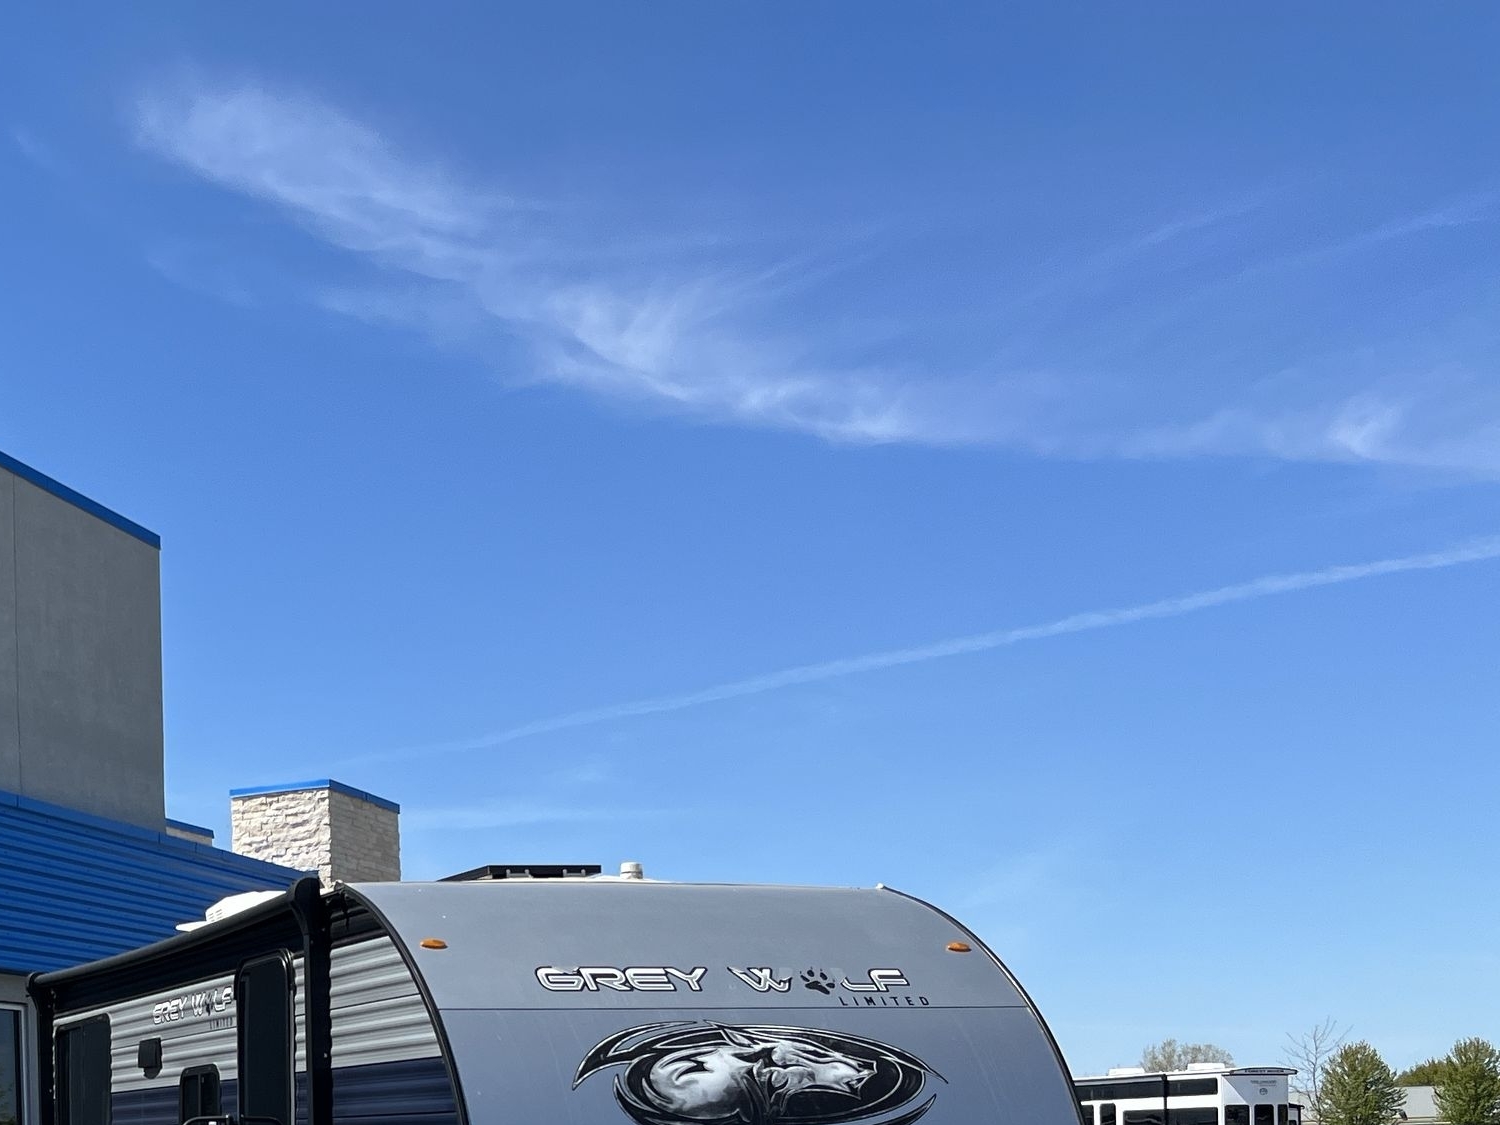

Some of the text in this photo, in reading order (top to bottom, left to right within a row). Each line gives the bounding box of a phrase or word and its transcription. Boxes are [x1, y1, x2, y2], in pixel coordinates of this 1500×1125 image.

[535, 966, 708, 992] GREY
[153, 994, 189, 1025] GREY
[838, 996, 930, 1007] LIMITED
